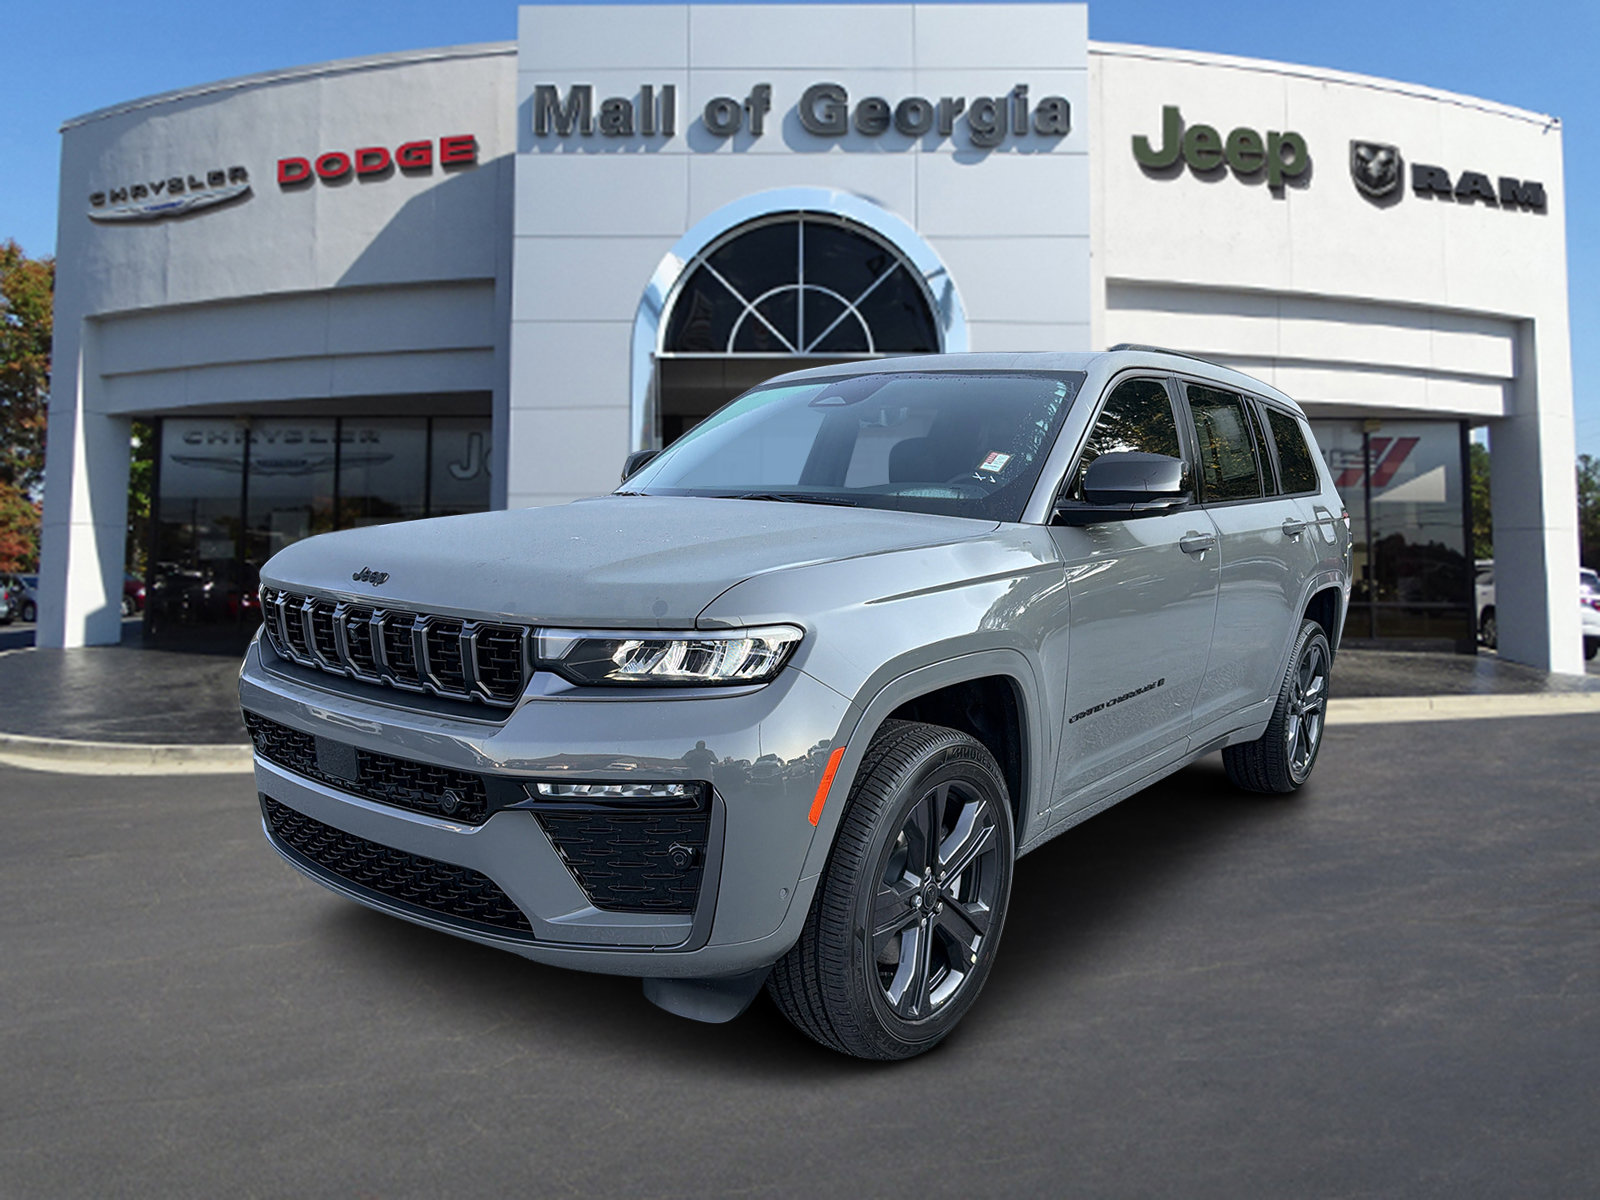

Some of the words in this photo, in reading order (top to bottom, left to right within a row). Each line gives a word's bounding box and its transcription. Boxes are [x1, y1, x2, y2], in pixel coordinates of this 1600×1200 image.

[532, 84, 677, 136] Mall
[704, 83, 772, 136] of
[800, 82, 1072, 148] Georgia
[277, 134, 477, 188] DODGE
[1132, 105, 1310, 190] Jeep
[89, 165, 249, 208] CHRYSLER
[1411, 162, 1547, 214] RAM
[183, 429, 381, 445] CHRYSLER
[447, 431, 492, 480] J
[352, 566, 390, 587] Jeep
